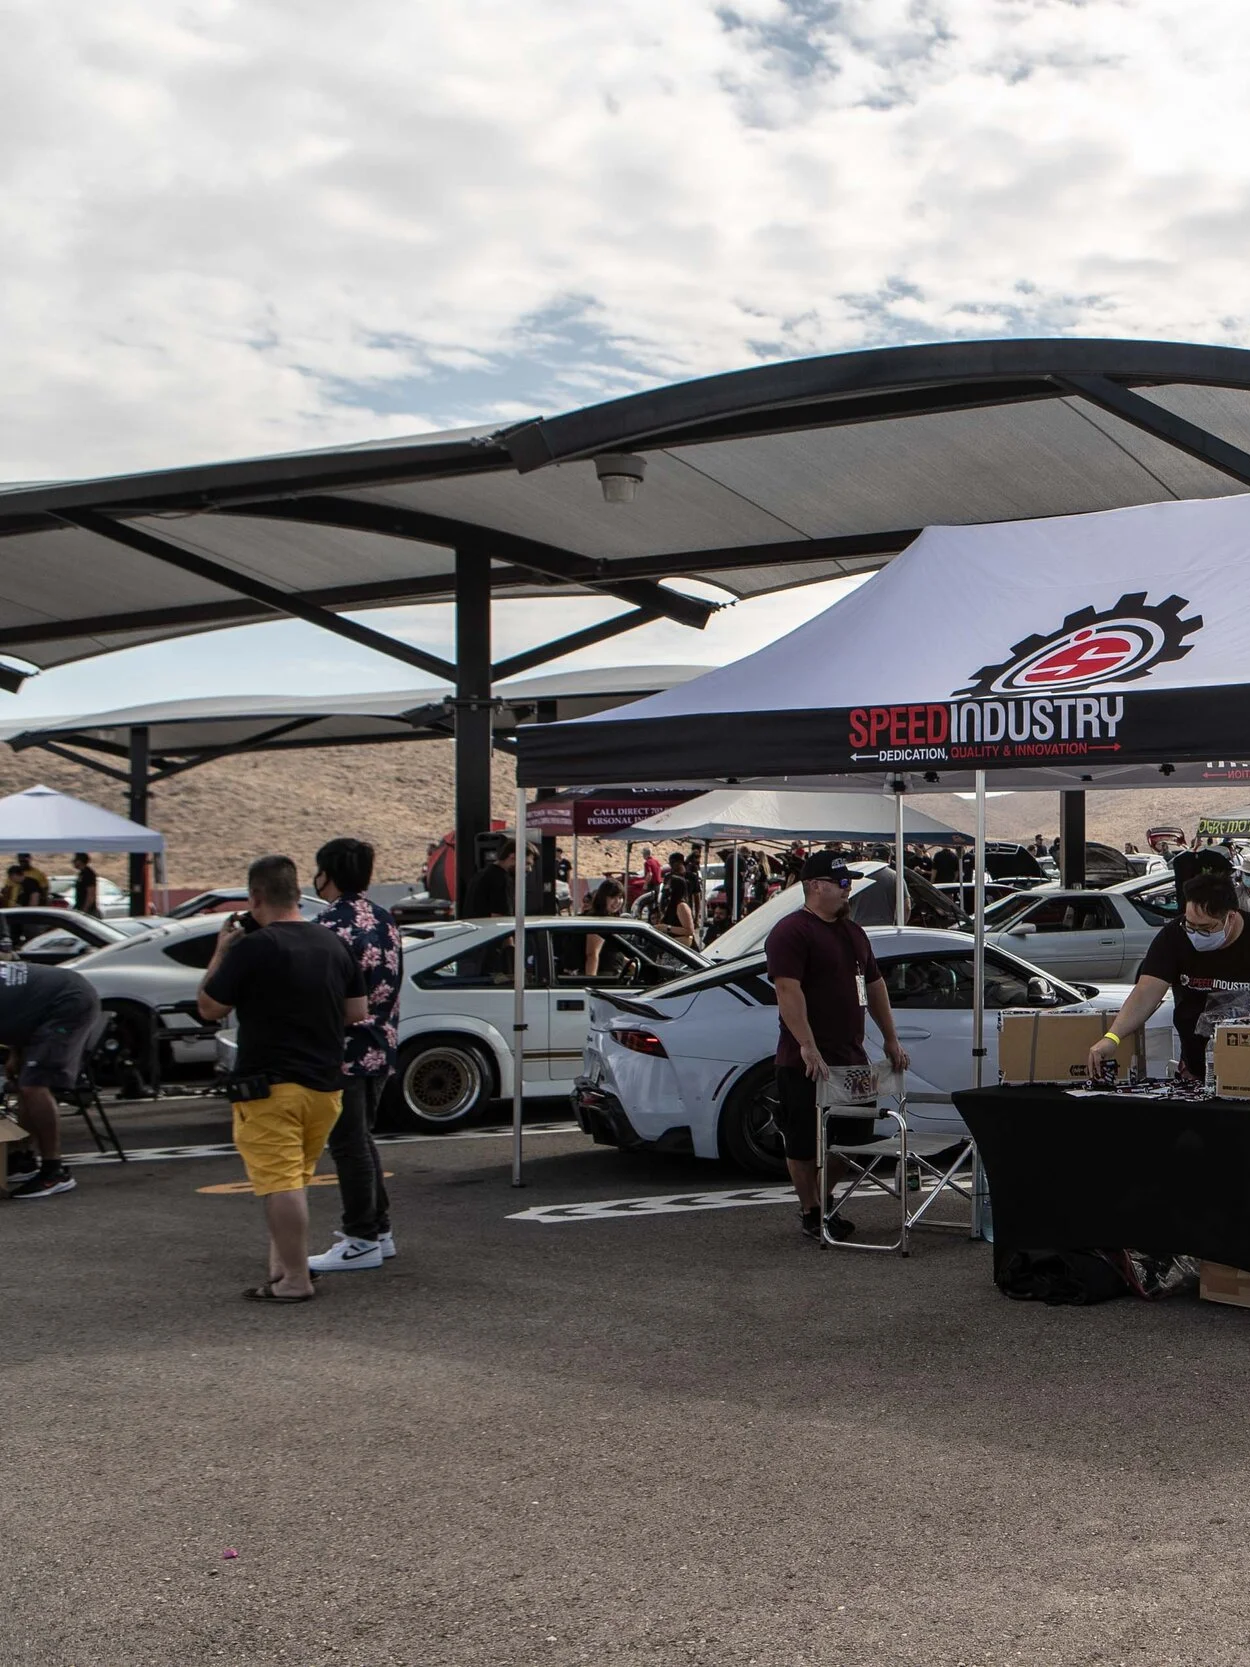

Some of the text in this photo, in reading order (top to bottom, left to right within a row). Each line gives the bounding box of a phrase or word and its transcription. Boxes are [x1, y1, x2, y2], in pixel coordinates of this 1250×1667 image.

[879, 742, 1088, 762] DEDICATION, QUALITY & INNOVATION
[593, 808, 616, 816] CALL
[617, 807, 650, 816] DIRECT
[587, 817, 633, 825] PERSONAL
